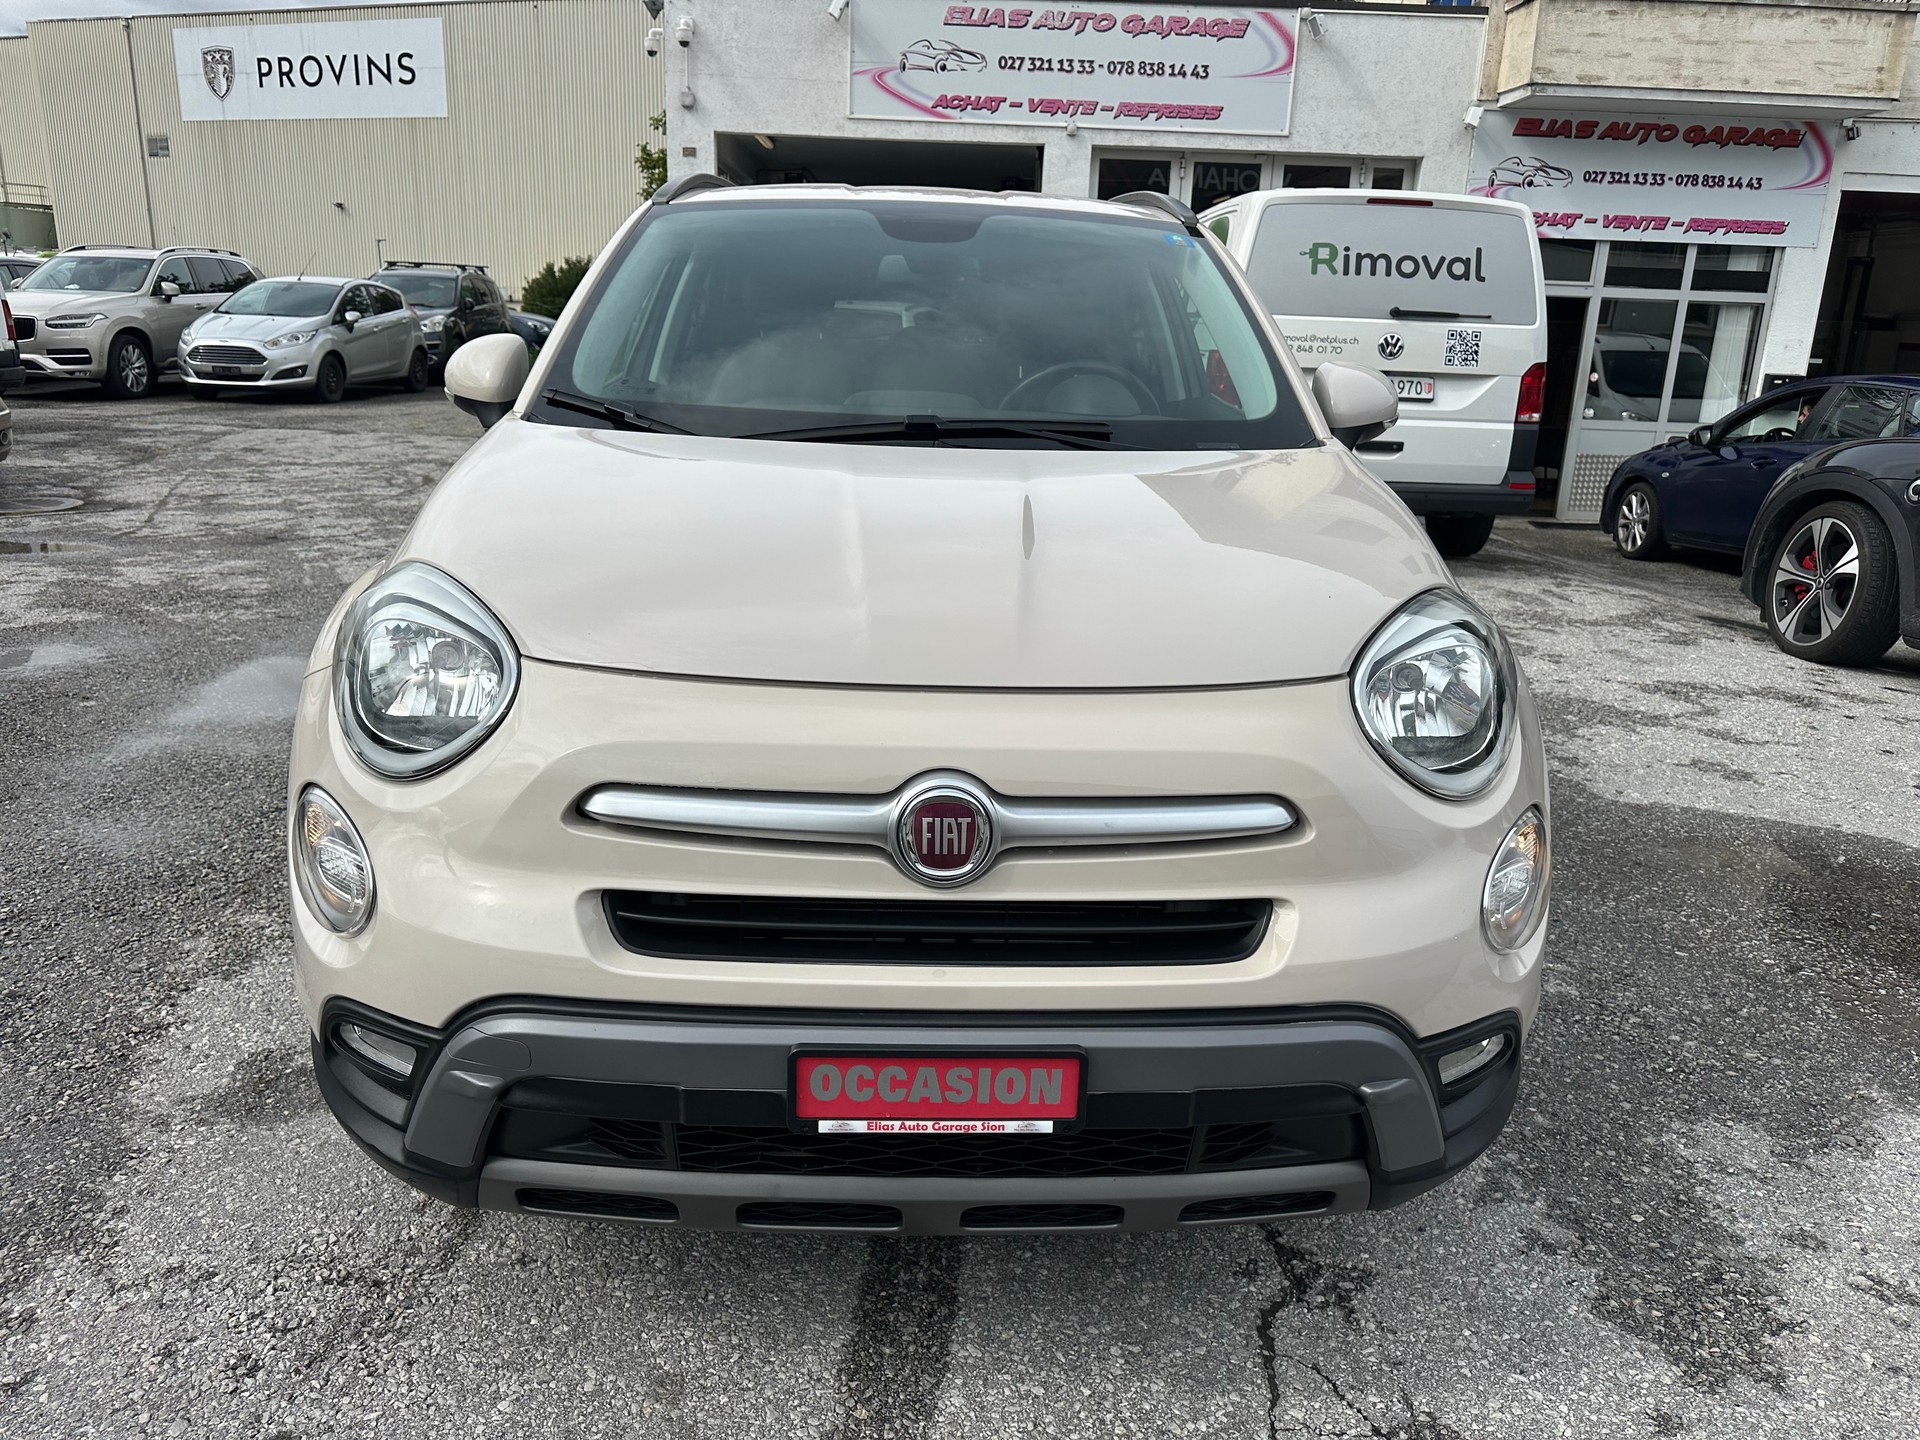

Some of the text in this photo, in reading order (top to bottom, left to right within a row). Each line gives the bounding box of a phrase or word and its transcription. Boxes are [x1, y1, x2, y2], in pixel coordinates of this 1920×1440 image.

[943, 6, 1251, 42] ELIAS AUTO GARAGE
[256, 52, 416, 88] PROVINS
[998, 55, 1025, 72] 027
[1027, 57, 1054, 72] 321
[1057, 58, 1074, 74] 13
[1077, 59, 1095, 74] 33
[1107, 60, 1135, 76] 078
[1137, 61, 1165, 77] 838
[1168, 63, 1187, 78] 14
[1190, 64, 1209, 79] 43
[931, 94, 1006, 115] ACHAT
[1027, 97, 1099, 118] VENTE
[1113, 101, 1224, 121] REPRISES
[1512, 117, 1807, 151] ELIAS AUTO GARAGE
[1583, 170, 1606, 184] 027
[1607, 171, 1630, 185] 321
[1632, 172, 1648, 186] 13
[1649, 173, 1666, 186] 33
[1675, 173, 1699, 188] 078
[1701, 174, 1725, 189] 838
[1727, 176, 1743, 190] 14
[1745, 177, 1763, 191] 43
[1602, 214, 1671, 232] VENTE
[1683, 217, 1790, 236] REPRISES
[1310, 241, 1485, 283] Rimoval
[1284, 334, 1359, 345] moval@netplus.ch
[1296, 345, 1314, 353] 848
[1391, 380, 1423, 395] 970
[922, 817, 971, 855] FIAT
[809, 1064, 1063, 1105] OCCASION
[866, 1121, 1005, 1134] Elias Auto Garage Sion
